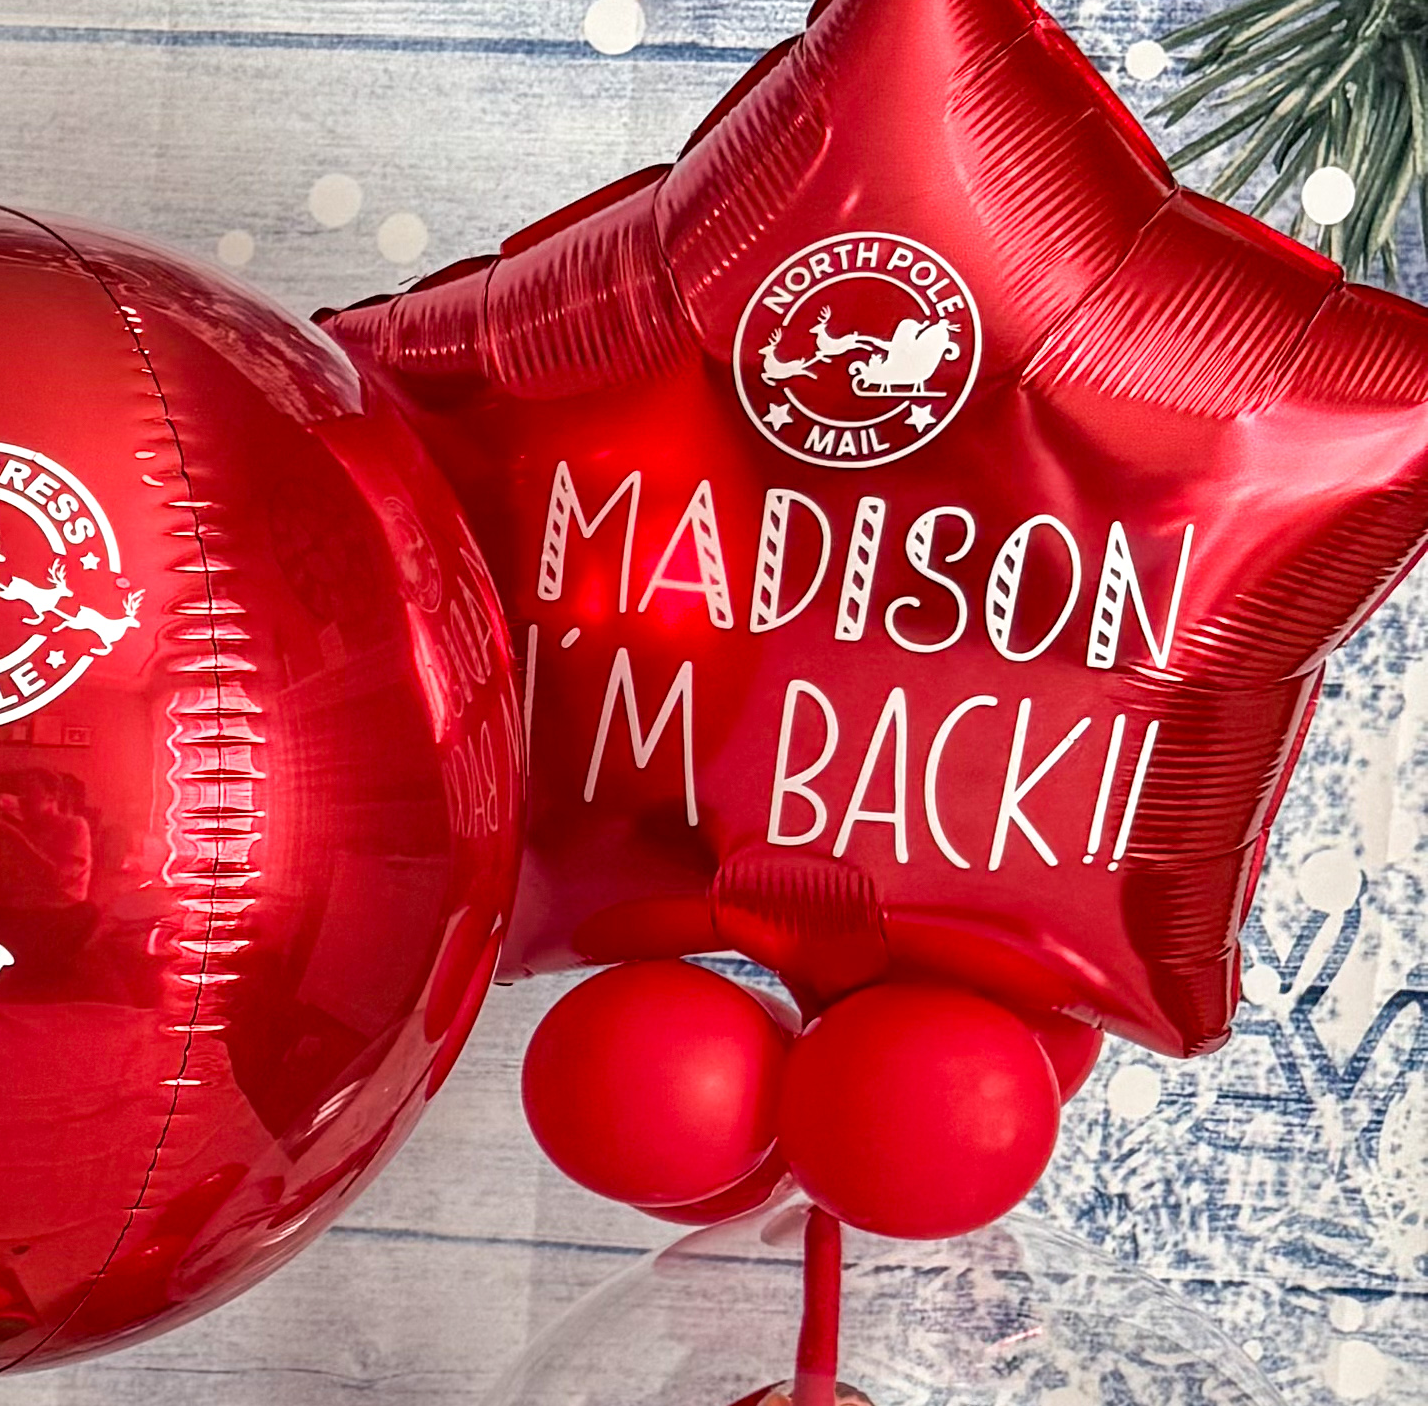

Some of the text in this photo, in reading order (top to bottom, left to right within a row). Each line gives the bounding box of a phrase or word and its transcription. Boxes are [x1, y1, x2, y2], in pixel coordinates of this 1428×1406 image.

[764, 245, 963, 315] NORTH POLE
[804, 426, 889, 457] MAIL
[539, 460, 1194, 670] MADISON
[523, 624, 1159, 872] I'M BACK!!
